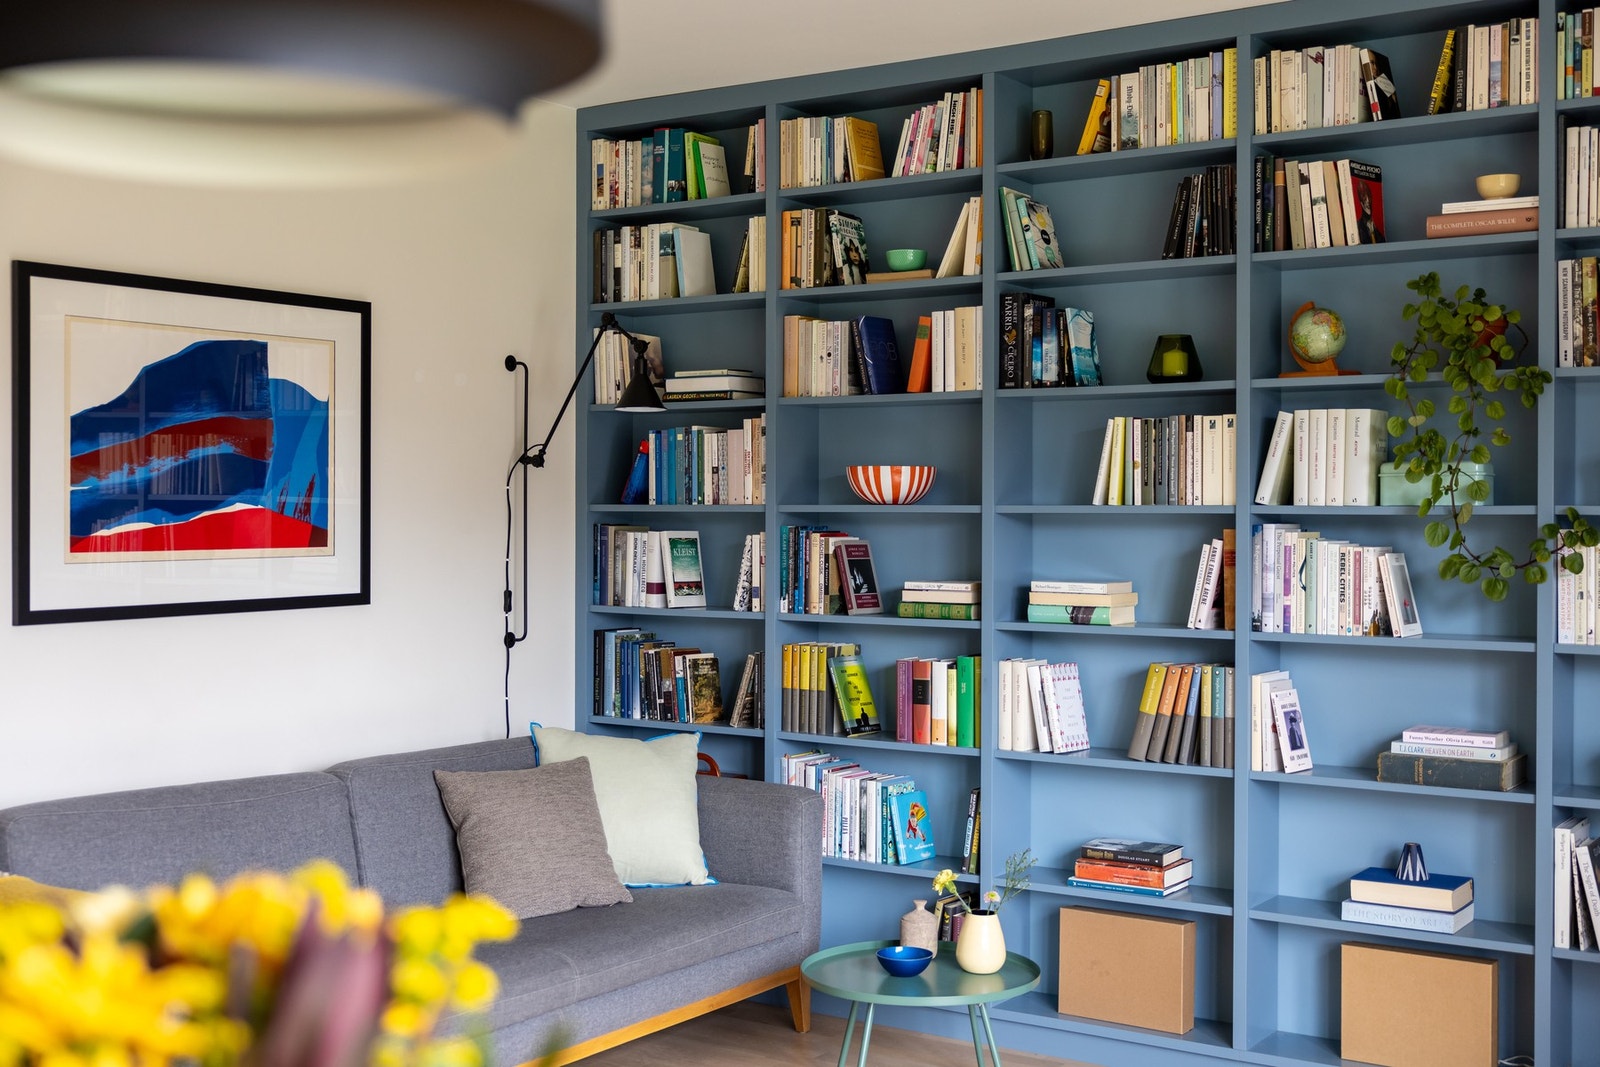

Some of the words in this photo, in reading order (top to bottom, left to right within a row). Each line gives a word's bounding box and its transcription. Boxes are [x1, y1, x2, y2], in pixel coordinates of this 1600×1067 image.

[1456, 70, 1464, 101] GLEMSEL
[1126, 85, 1134, 119] Moby-Dick
[949, 100, 958, 135] HIGH-RISE
[1350, 162, 1367, 171] AMERICAN
[1367, 166, 1381, 174] PSYCHO
[1188, 204, 1196, 233] PORTUGAL
[1443, 222, 1474, 230] COMPLETE
[1004, 296, 1012, 331] HARRIS
[1007, 346, 1015, 378] CICERO
[1277, 418, 1287, 438] Hobbes
[1331, 416, 1339, 440] Benjamin
[673, 548, 696, 556] KLEIST
[1209, 546, 1218, 562] ANNIE
[1204, 563, 1214, 585] ERNAUX
[1407, 745, 1425, 753] CLARK
[1425, 747, 1447, 755] HEAVEN
[1447, 748, 1456, 756] ON
[1456, 749, 1475, 757] EARTH
[1461, 737, 1474, 745] Laing
[1584, 875, 1593, 890] Sight
[1591, 899, 1599, 916] Death
[1352, 909, 1371, 917] THE
[1374, 911, 1402, 921] STORY
[1404, 915, 1417, 924] OF
[1421, 918, 1438, 927] ART
